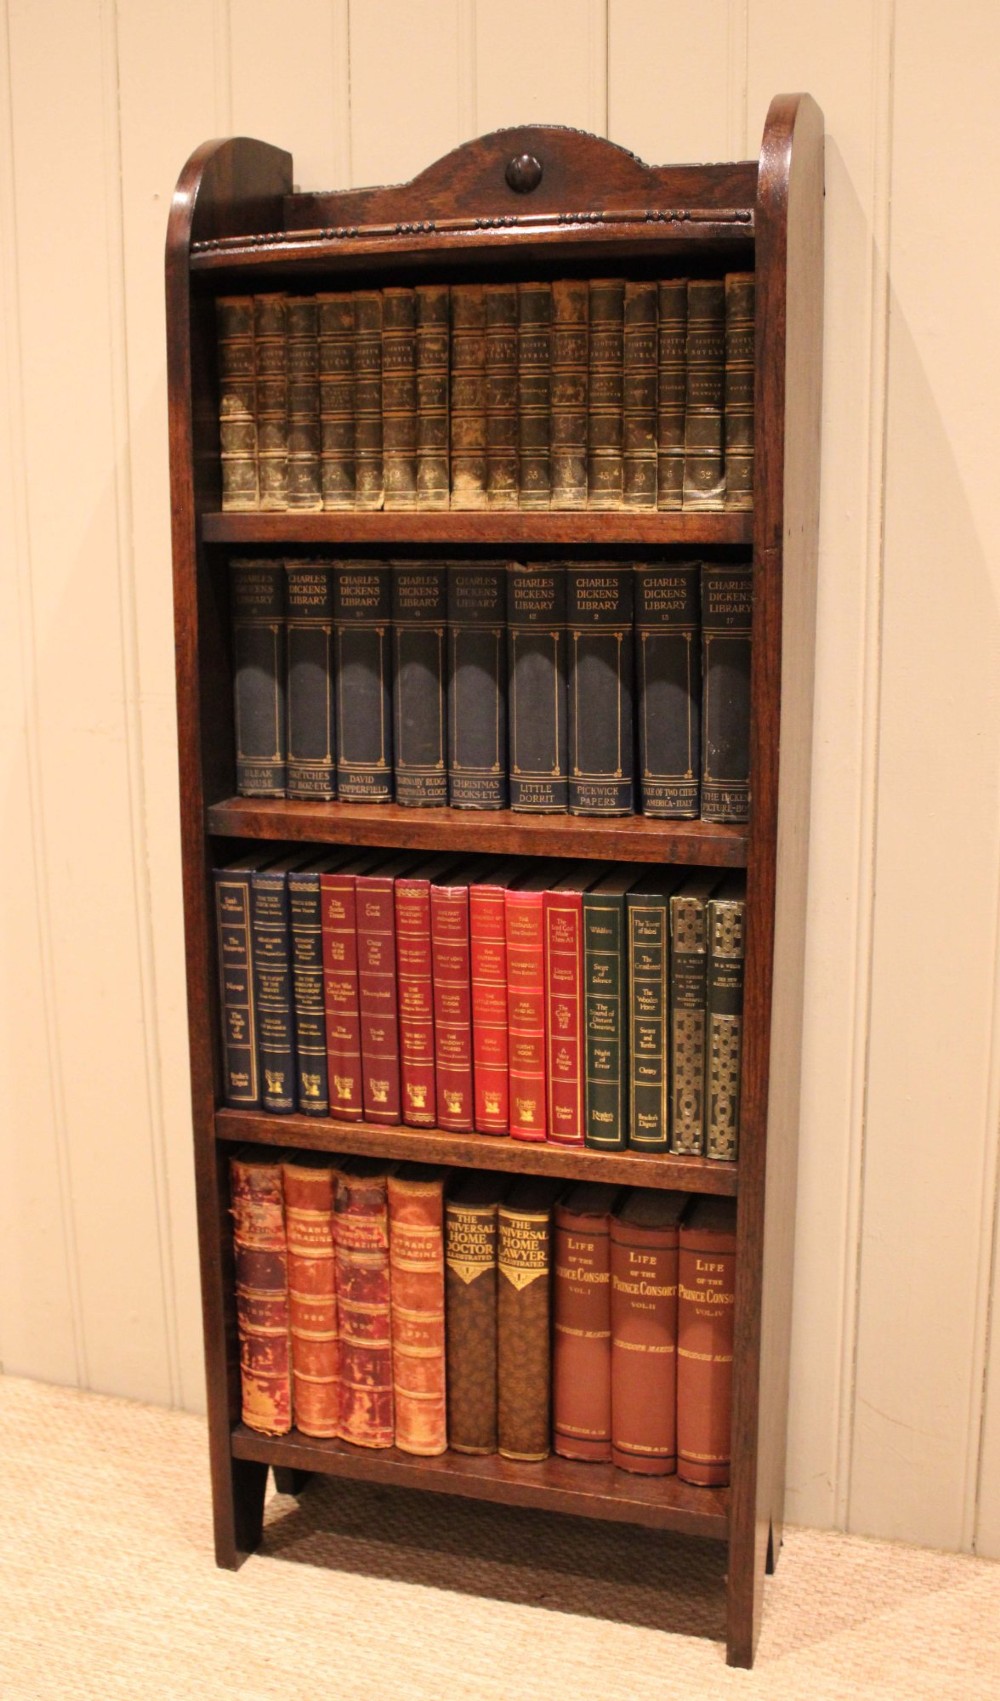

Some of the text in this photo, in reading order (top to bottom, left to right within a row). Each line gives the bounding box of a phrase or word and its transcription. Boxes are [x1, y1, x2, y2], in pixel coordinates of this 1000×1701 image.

[288, 574, 327, 583] CHARLES
[339, 576, 380, 584] CHARLES
[398, 576, 439, 585] CHARLES
[514, 579, 554, 587] CHARLES
[576, 579, 619, 587] CHARLES
[643, 578, 686, 587] CHARLES
[289, 585, 327, 594] DICKENS
[340, 587, 380, 595] DICKENS
[399, 587, 439, 595] DICKENS
[514, 590, 554, 598] DICKENS
[576, 590, 619, 598] DICKENS
[644, 590, 687, 598] DICKENS
[289, 596, 327, 605] LIBRARY
[341, 598, 380, 606] LIBRARY
[400, 599, 439, 607] LIBRARY
[515, 601, 554, 610] LIBRARY
[577, 601, 619, 610] LIBRARY
[645, 601, 687, 610] LIBRARY
[350, 775, 374, 784] DAVID
[453, 779, 499, 789] CHRISTMAS
[339, 785, 388, 794] COPPERFIELD
[520, 784, 552, 793] LITTLE
[577, 786, 619, 796] PICKWICK
[665, 788, 678, 797] TWO
[679, 788, 698, 797] CITIES
[519, 794, 555, 803] DORRIT
[580, 797, 616, 806] PAPERS
[634, 919, 660, 928] The Tower
[641, 955, 652, 963] The
[592, 976, 612, 984] Silence
[642, 988, 653, 996] The
[596, 1003, 608, 1011] The
[594, 1048, 611, 1057] Night
[594, 1061, 610, 1070] Error
[638, 1113, 658, 1121] Reader's
[638, 1120, 657, 1129] Digest
[457, 1214, 478, 1224] THE
[447, 1221, 496, 1234] NIVERSAL
[510, 1220, 531, 1230] THE
[450, 1231, 487, 1244] HOME
[500, 1226, 549, 1240] NIVERSAL
[502, 1236, 540, 1251] HOME
[567, 1238, 595, 1252] LIFE
[629, 1252, 657, 1265] LIFE
[696, 1259, 725, 1273] LIFE
[641, 1271, 656, 1279] THE
[613, 1275, 677, 1297] PRINCE CONSORT
[678, 1283, 706, 1303] PRINCE
